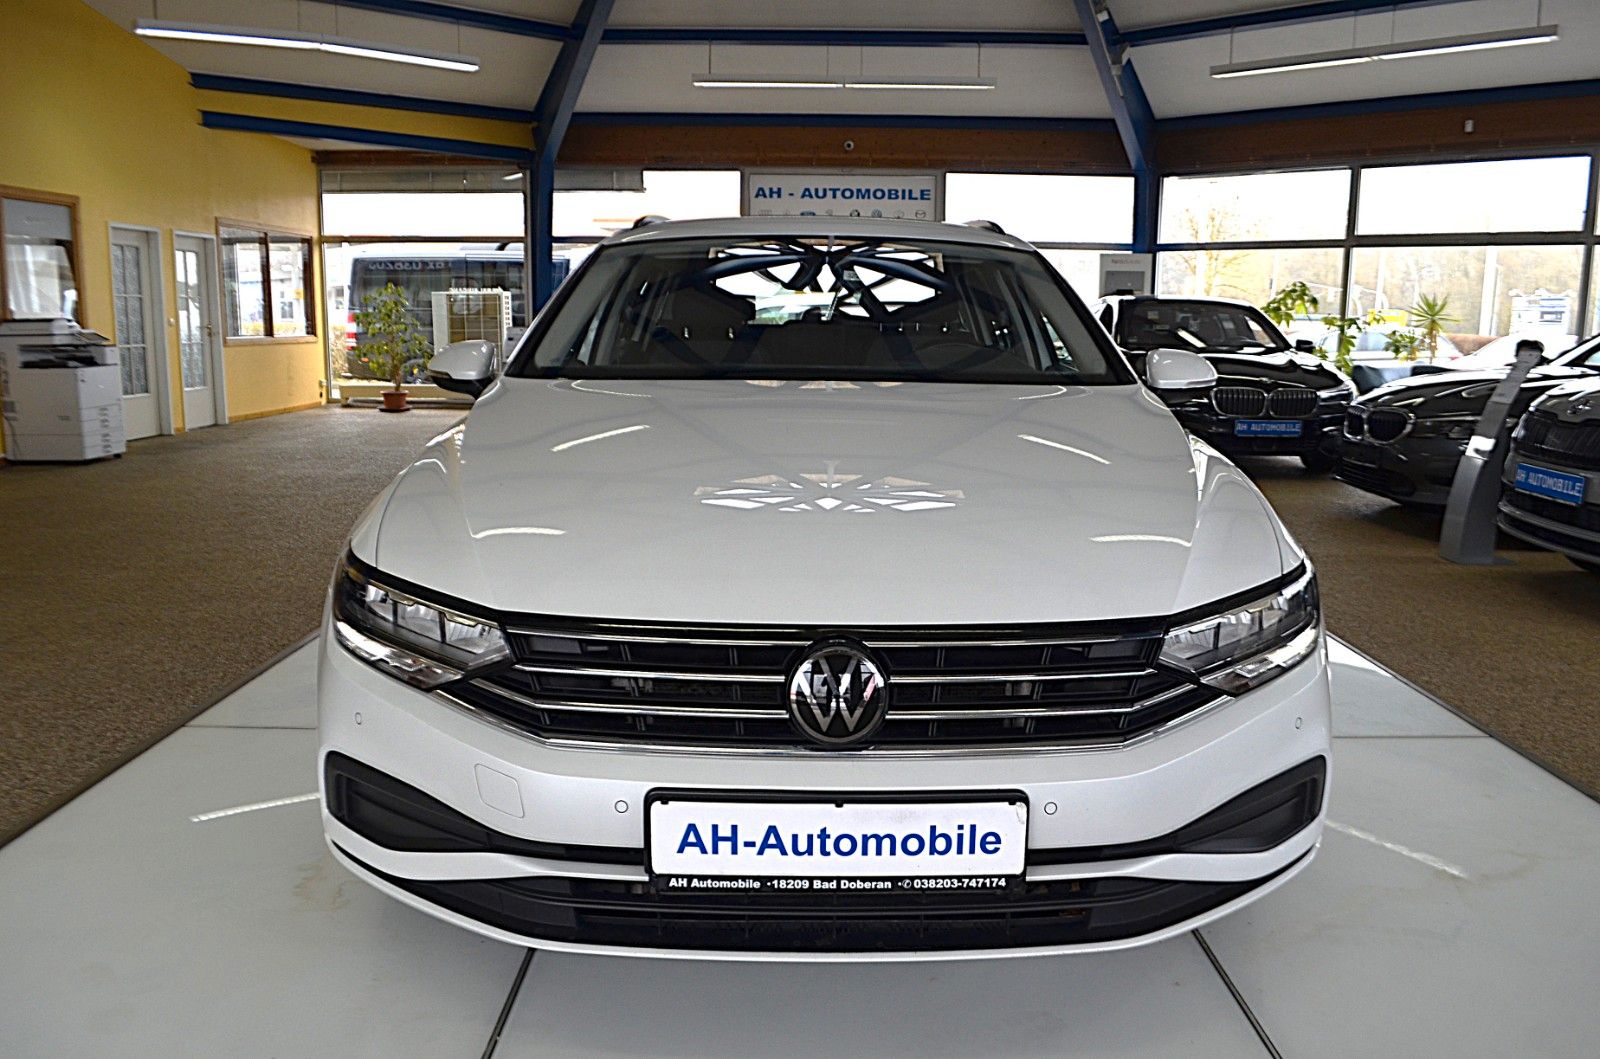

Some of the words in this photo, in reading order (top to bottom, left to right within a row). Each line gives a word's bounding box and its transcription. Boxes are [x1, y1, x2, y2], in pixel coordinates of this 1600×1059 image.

[754, 187, 781, 198] AH
[801, 188, 931, 200] AUTOMOBILE
[1236, 423, 1248, 431] AH
[1250, 423, 1301, 432] AUTOMOBILE
[1528, 472, 1583, 496] AUTOMOBILE
[677, 823, 1001, 856] AH-Automobile
[669, 878, 687, 887] AH
[691, 879, 760, 888] Automobile
[813, 880, 836, 888] Bad
[841, 880, 891, 888] Doberan
[914, 878, 1006, 888] 038203-747174
